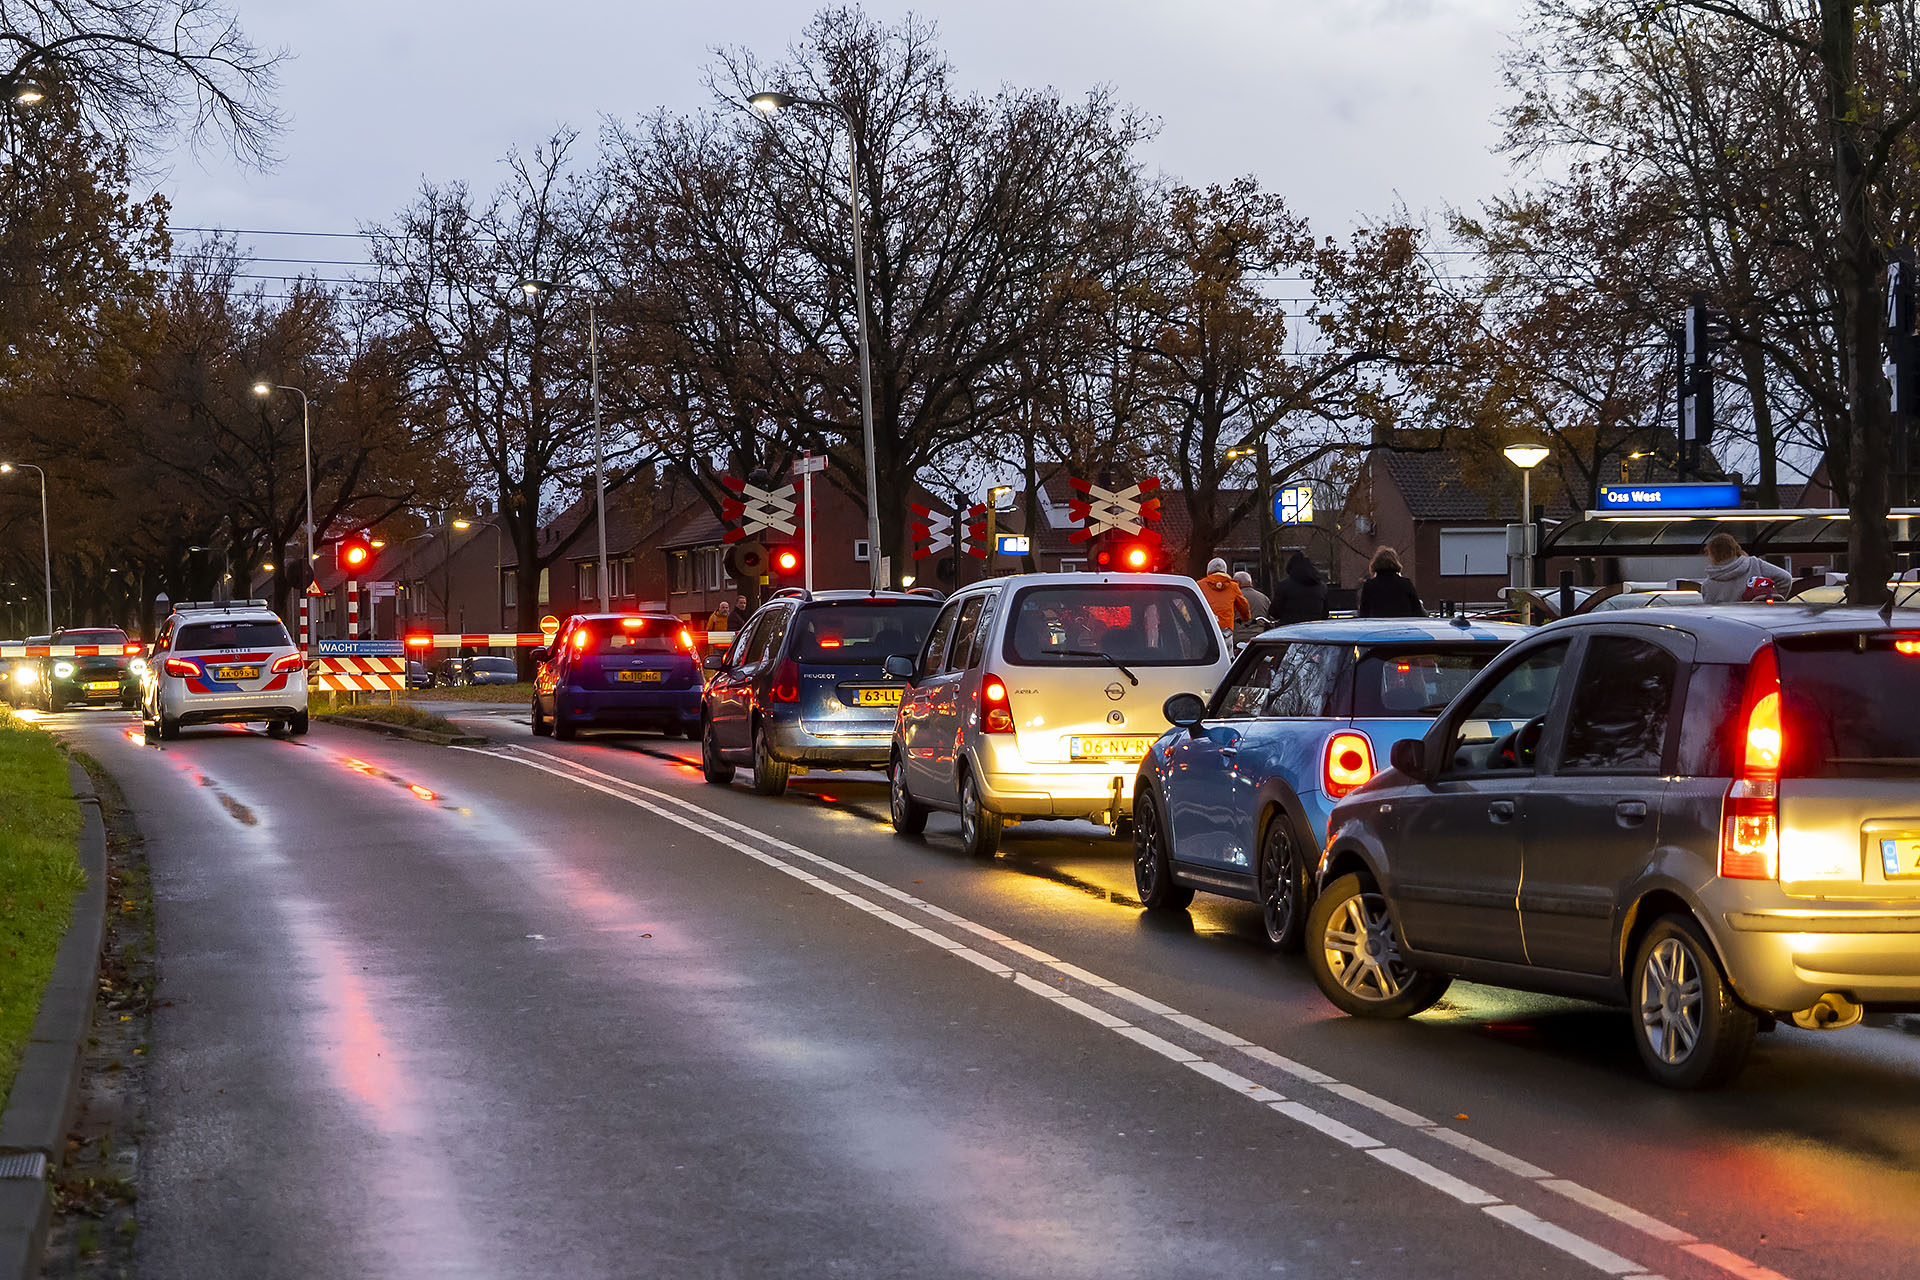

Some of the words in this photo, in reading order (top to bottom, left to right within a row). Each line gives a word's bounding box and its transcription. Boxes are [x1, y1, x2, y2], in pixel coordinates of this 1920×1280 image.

[1607, 491, 1629, 503] Oss
[1631, 491, 1662, 502] West
[319, 643, 359, 652] WACHT
[865, 690, 903, 702] 63-LL-
